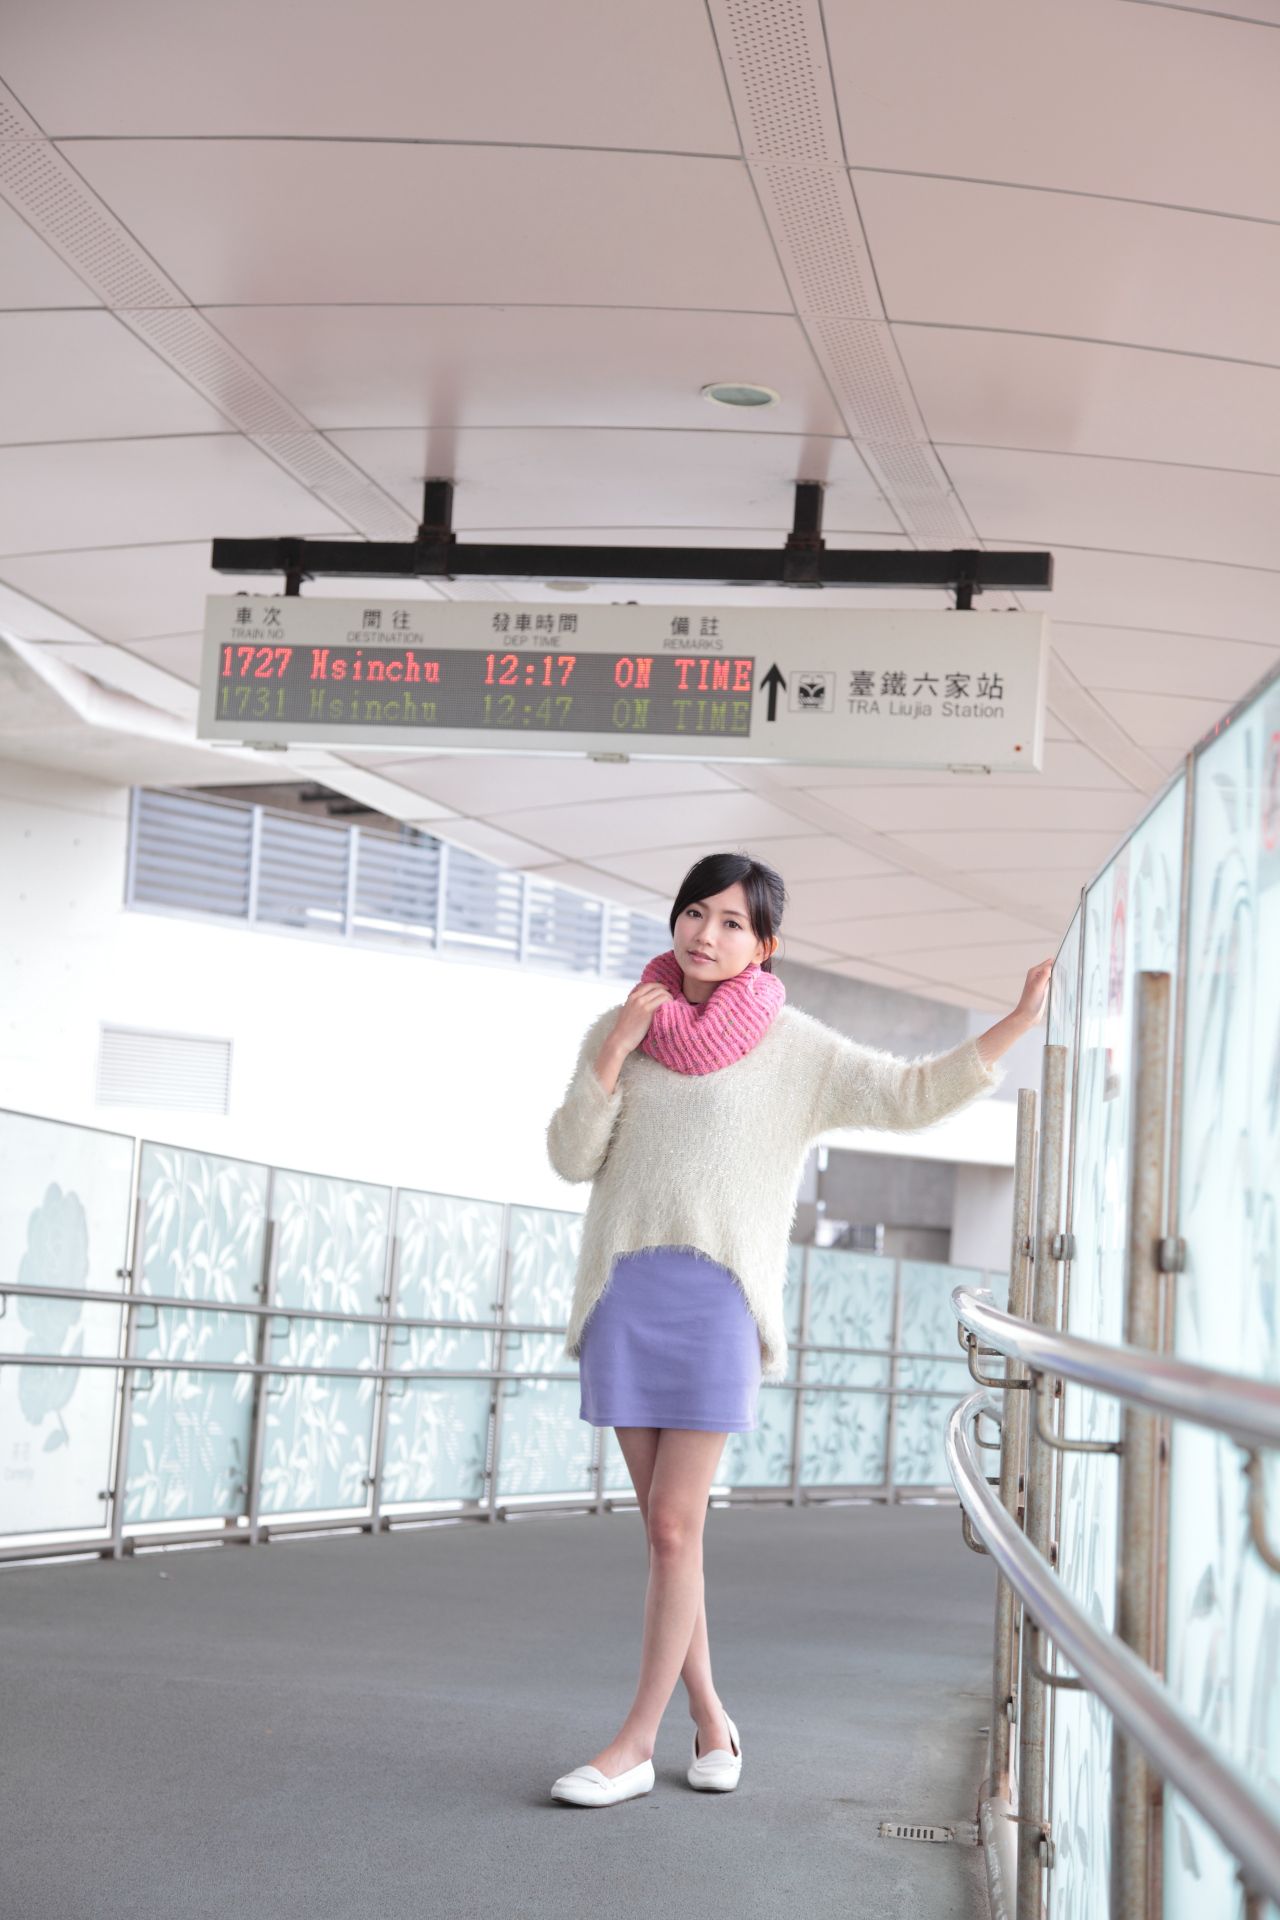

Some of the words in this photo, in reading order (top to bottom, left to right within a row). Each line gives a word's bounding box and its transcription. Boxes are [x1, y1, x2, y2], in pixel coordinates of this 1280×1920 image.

[235, 607, 282, 626] 車次
[493, 612, 578, 633] 發車時間
[670, 616, 719, 637] 備註
[231, 627, 264, 640] TRAIN
[347, 631, 424, 644] DESTINATION
[504, 635, 529, 647] DEP
[533, 636, 562, 648] TIME
[663, 638, 724, 651] REMARKS
[222, 646, 293, 679] 1727
[310, 649, 440, 683] Hsinchu
[484, 654, 577, 687] 12:17
[614, 657, 654, 688] ON
[674, 658, 753, 692] TIME
[850, 670, 1004, 700] 臺鐵六家站
[221, 686, 286, 719] 1731
[310, 688, 437, 722] Hsinchu
[482, 694, 574, 726] 12:47
[611, 699, 650, 729] ON
[671, 699, 751, 732] TIME
[847, 699, 881, 714] TRA
[889, 701, 932, 719] Liujia
[941, 702, 1005, 718] Station
